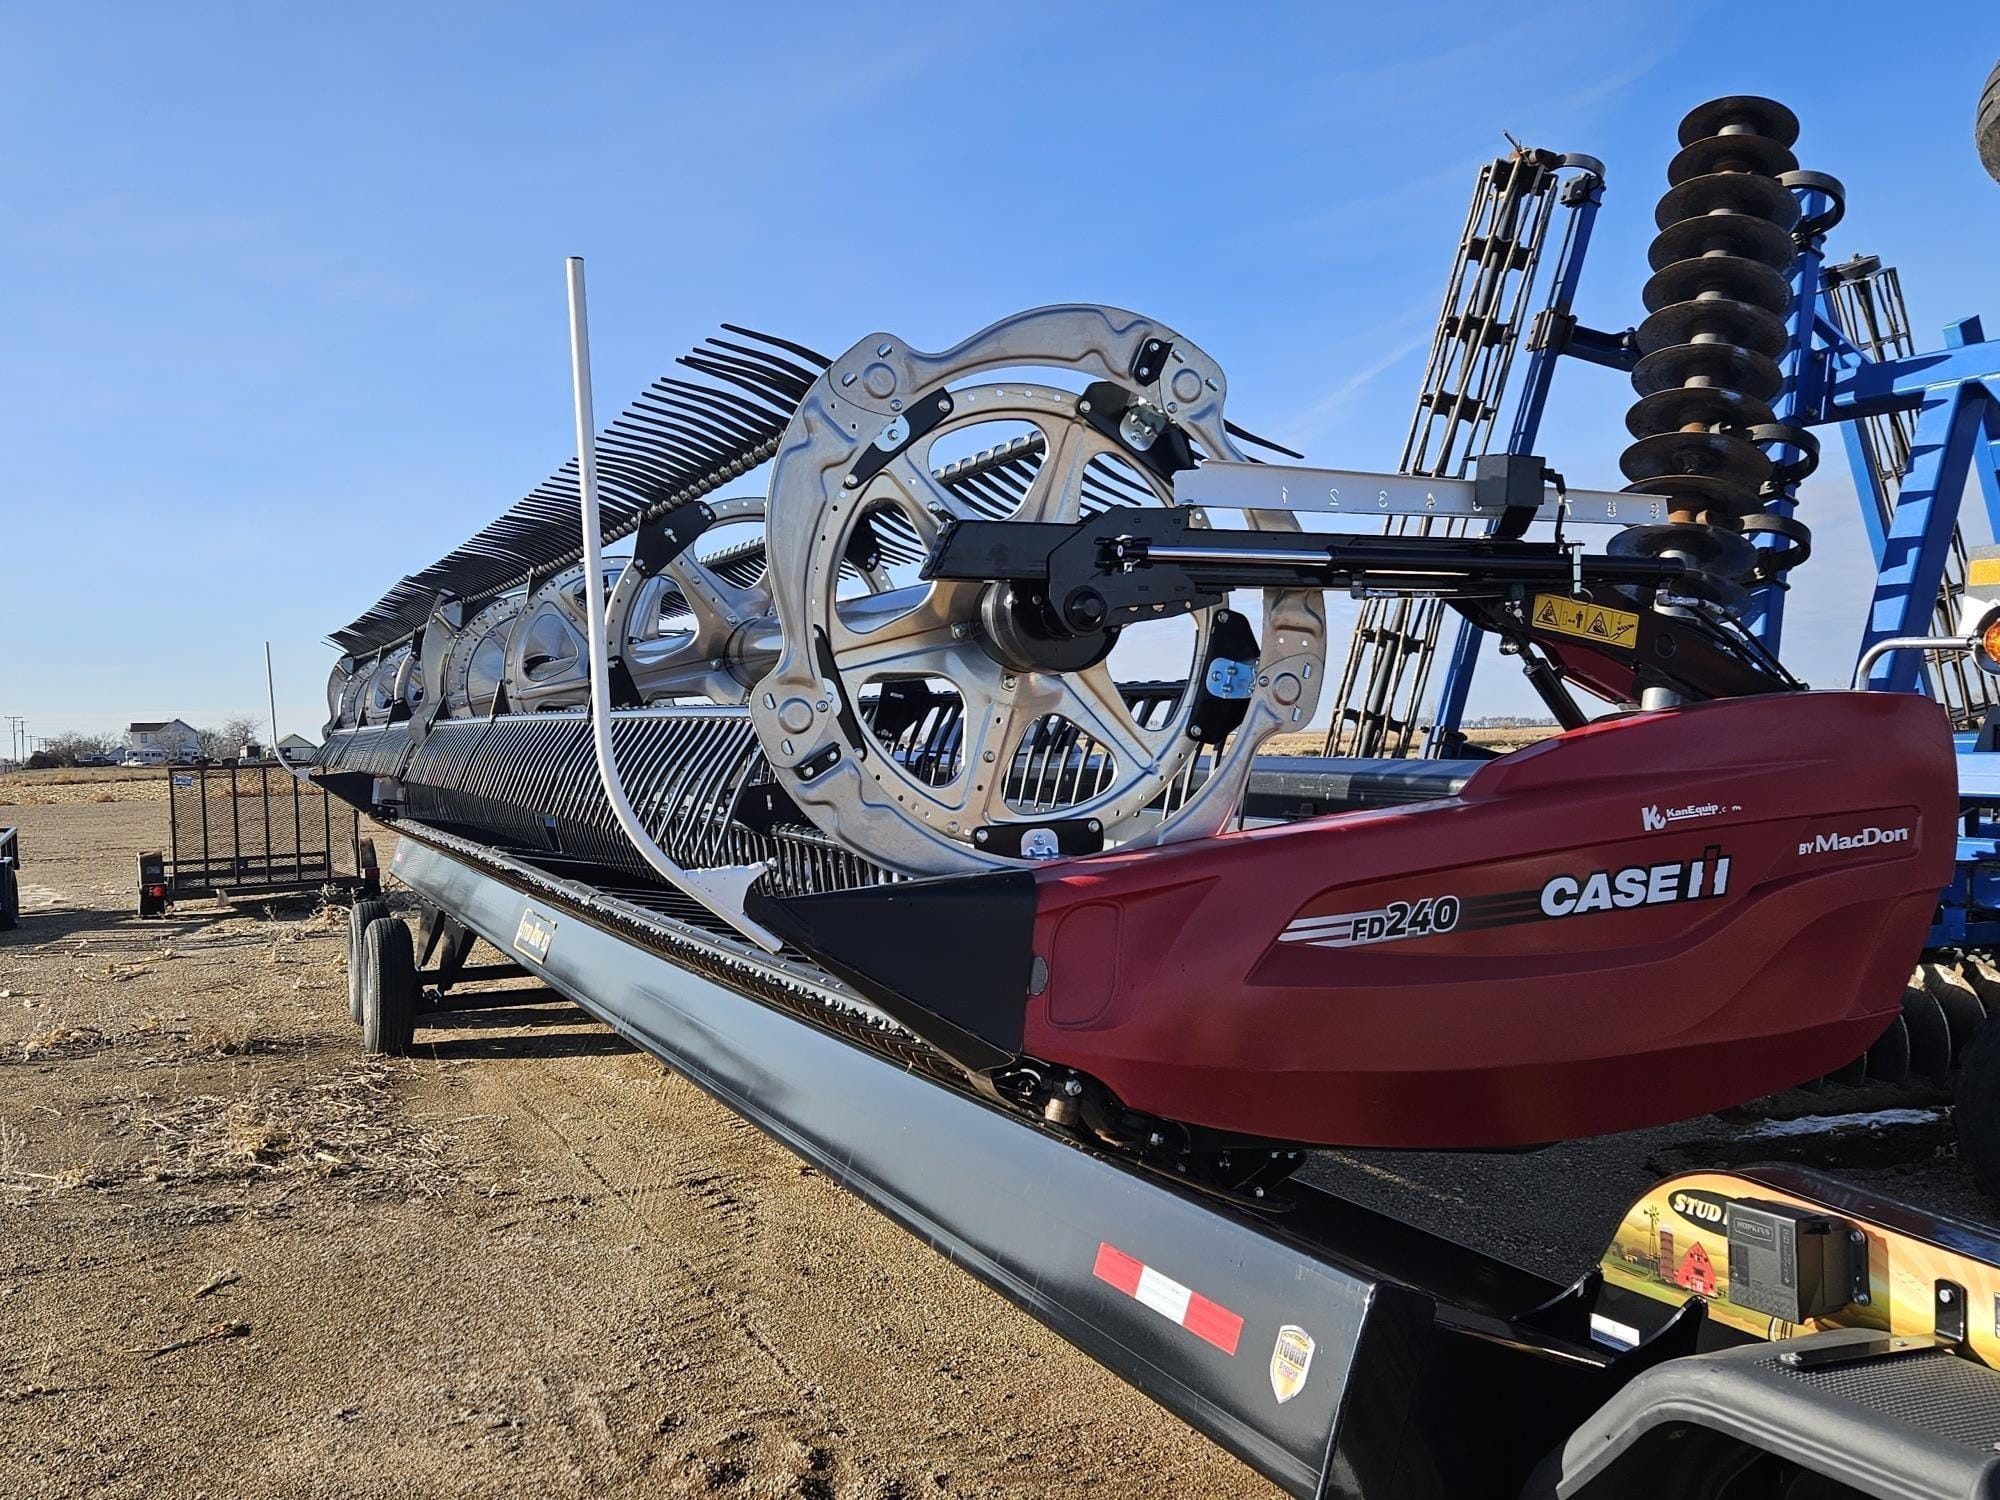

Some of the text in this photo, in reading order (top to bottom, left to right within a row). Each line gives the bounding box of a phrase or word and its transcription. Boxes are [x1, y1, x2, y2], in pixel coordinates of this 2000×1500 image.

[1798, 828, 1909, 855] BY MacDon
[1540, 864, 1681, 917] CASE
[1350, 895, 1461, 942] FD240
[1673, 1193, 1722, 1223] STUD
[1736, 1220, 1771, 1236] HOPKINS
[1278, 1340, 1308, 1369] TOUGH
